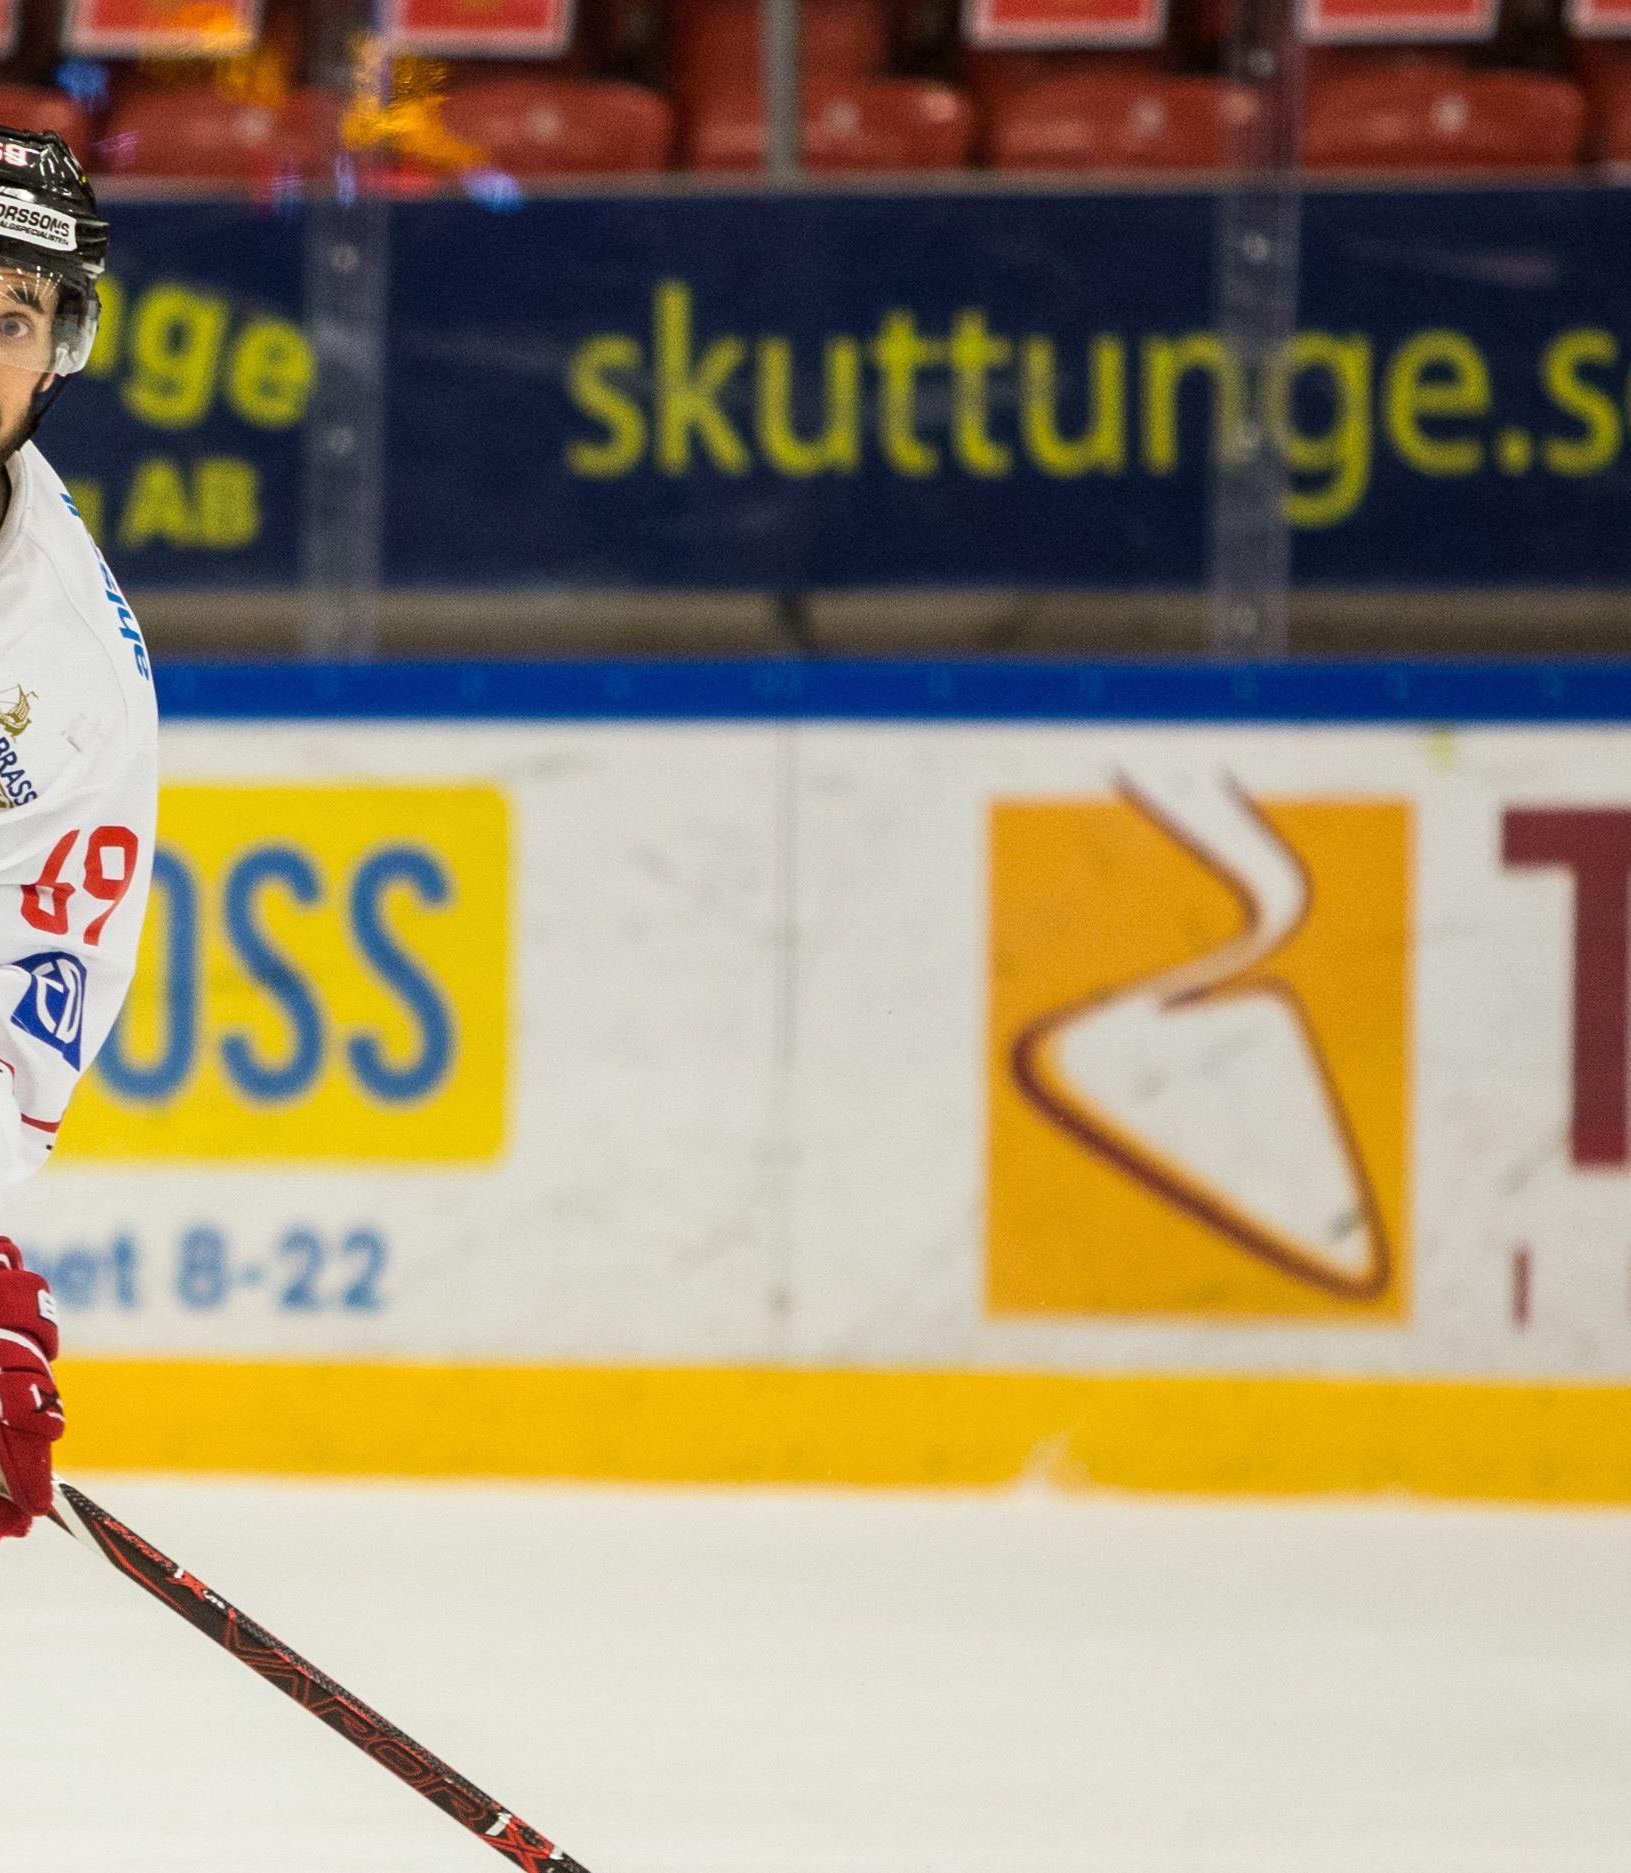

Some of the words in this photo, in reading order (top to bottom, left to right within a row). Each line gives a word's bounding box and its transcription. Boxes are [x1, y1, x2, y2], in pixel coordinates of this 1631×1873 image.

[567, 280, 1631, 531] skuttunge.s
[118, 458, 262, 550] AB
[20, 825, 139, 947] 69
